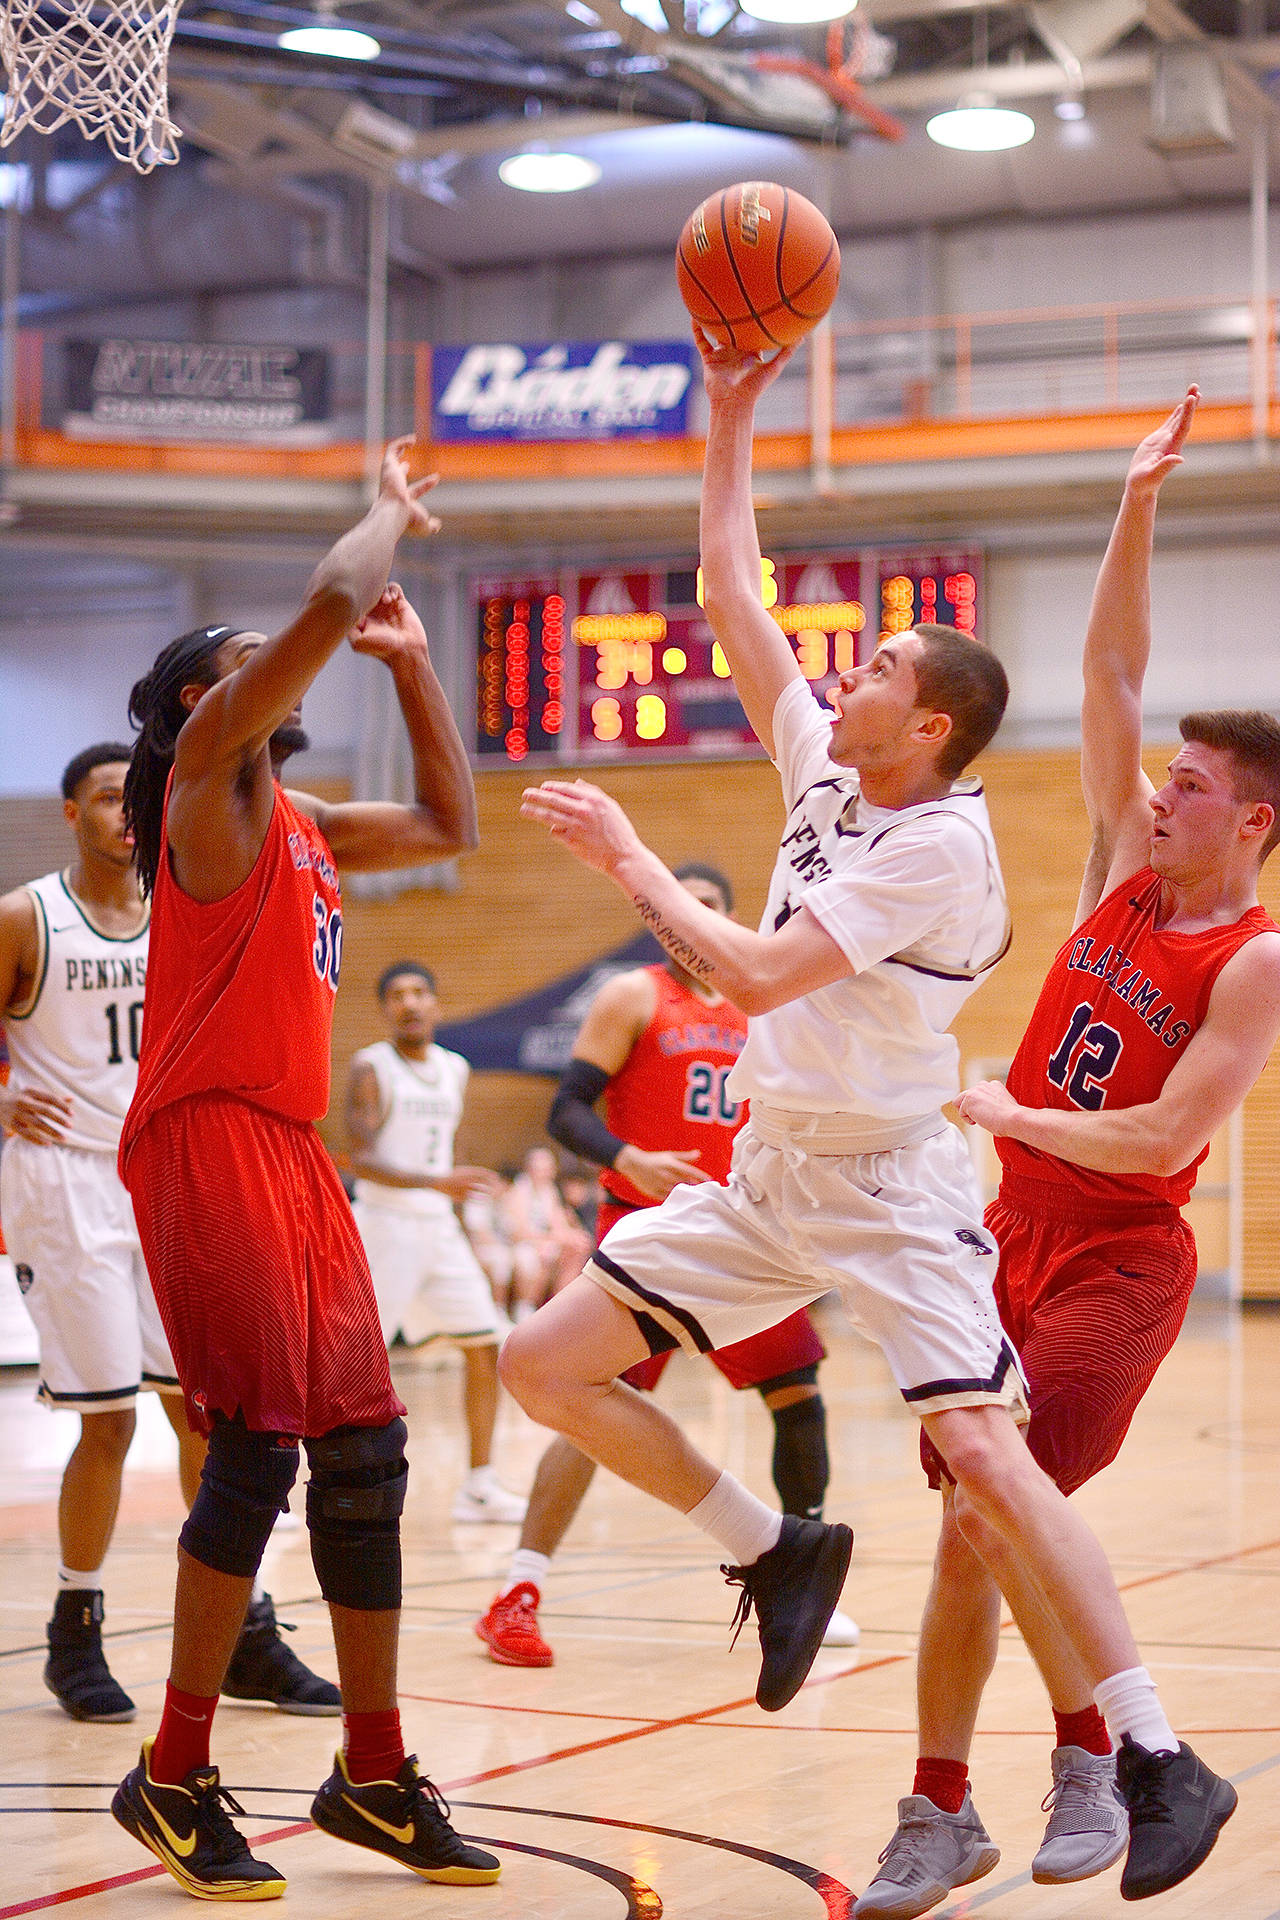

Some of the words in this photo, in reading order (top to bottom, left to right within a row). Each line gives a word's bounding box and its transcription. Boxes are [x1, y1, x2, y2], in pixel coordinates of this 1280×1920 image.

[66, 958, 146, 990] PENINS
[313, 891, 343, 994] 30
[1067, 937, 1191, 1049] CLACKAMAS
[683, 1061, 743, 1128] 20
[1047, 1000, 1125, 1112] 12
